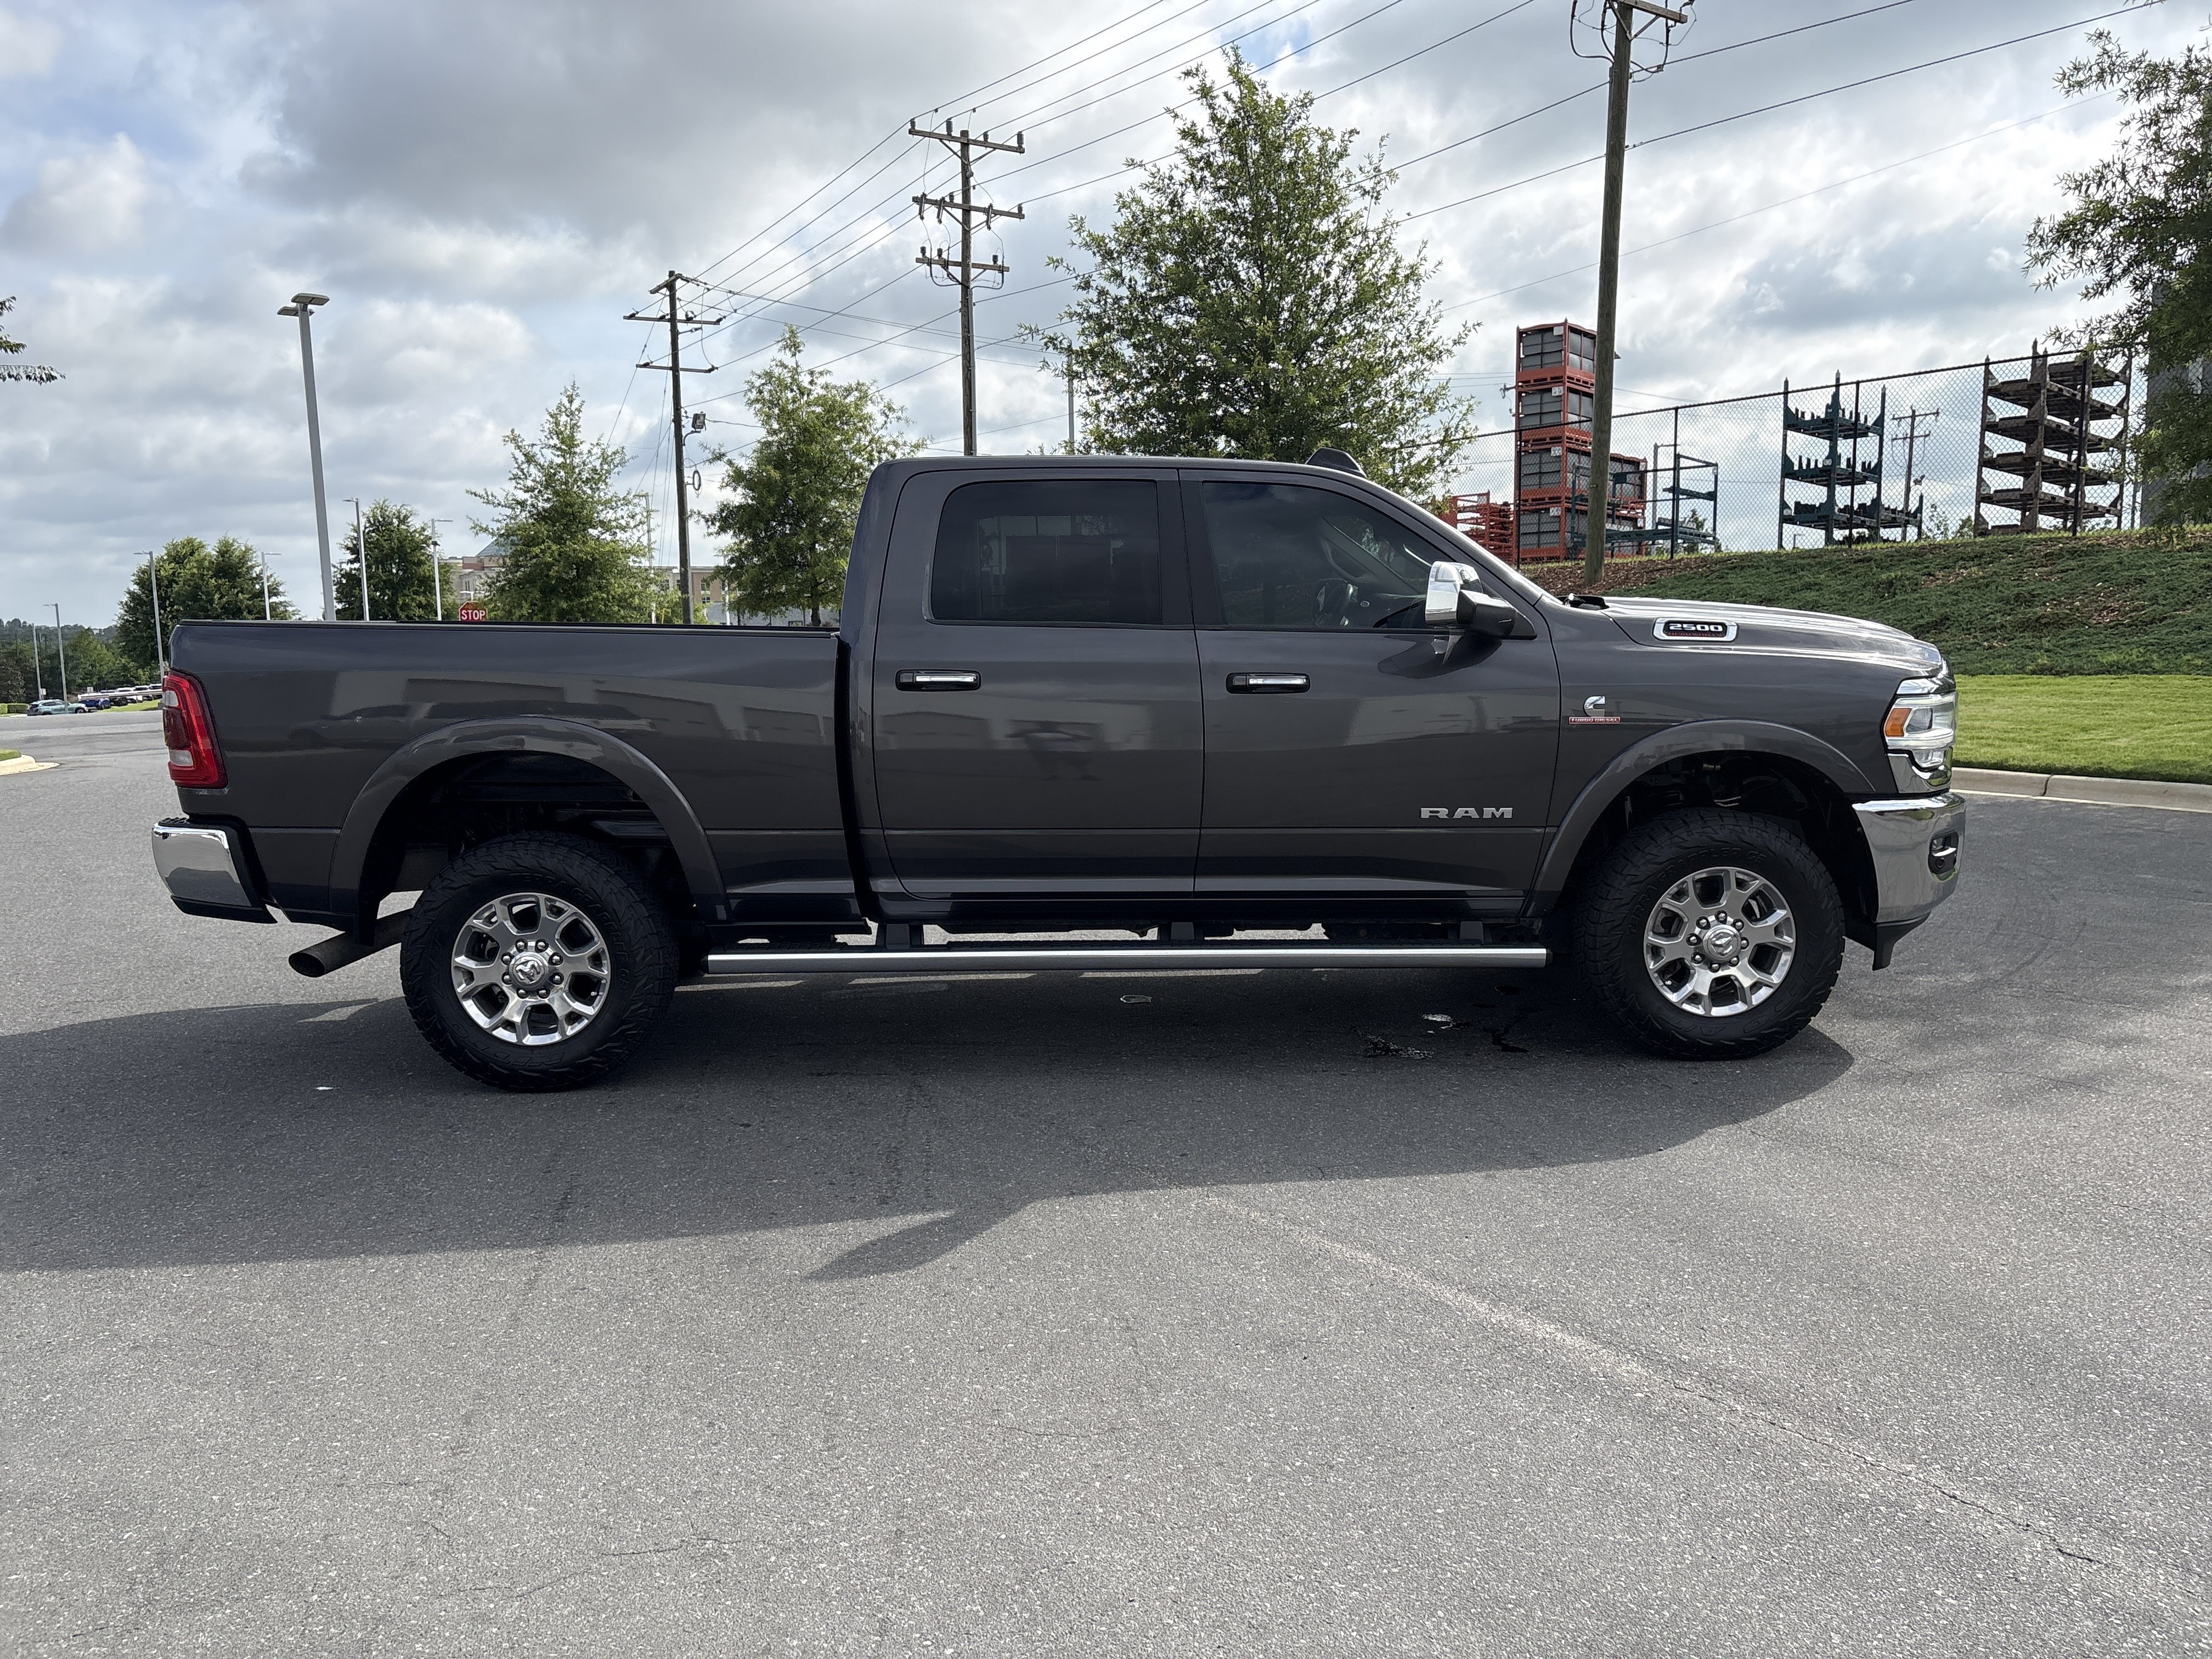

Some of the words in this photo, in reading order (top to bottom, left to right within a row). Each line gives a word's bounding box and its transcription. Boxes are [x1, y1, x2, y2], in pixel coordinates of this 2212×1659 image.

[461, 610, 486, 620] STOP
[1668, 623, 1723, 631] 2500
[1420, 808, 1513, 819] RAM
